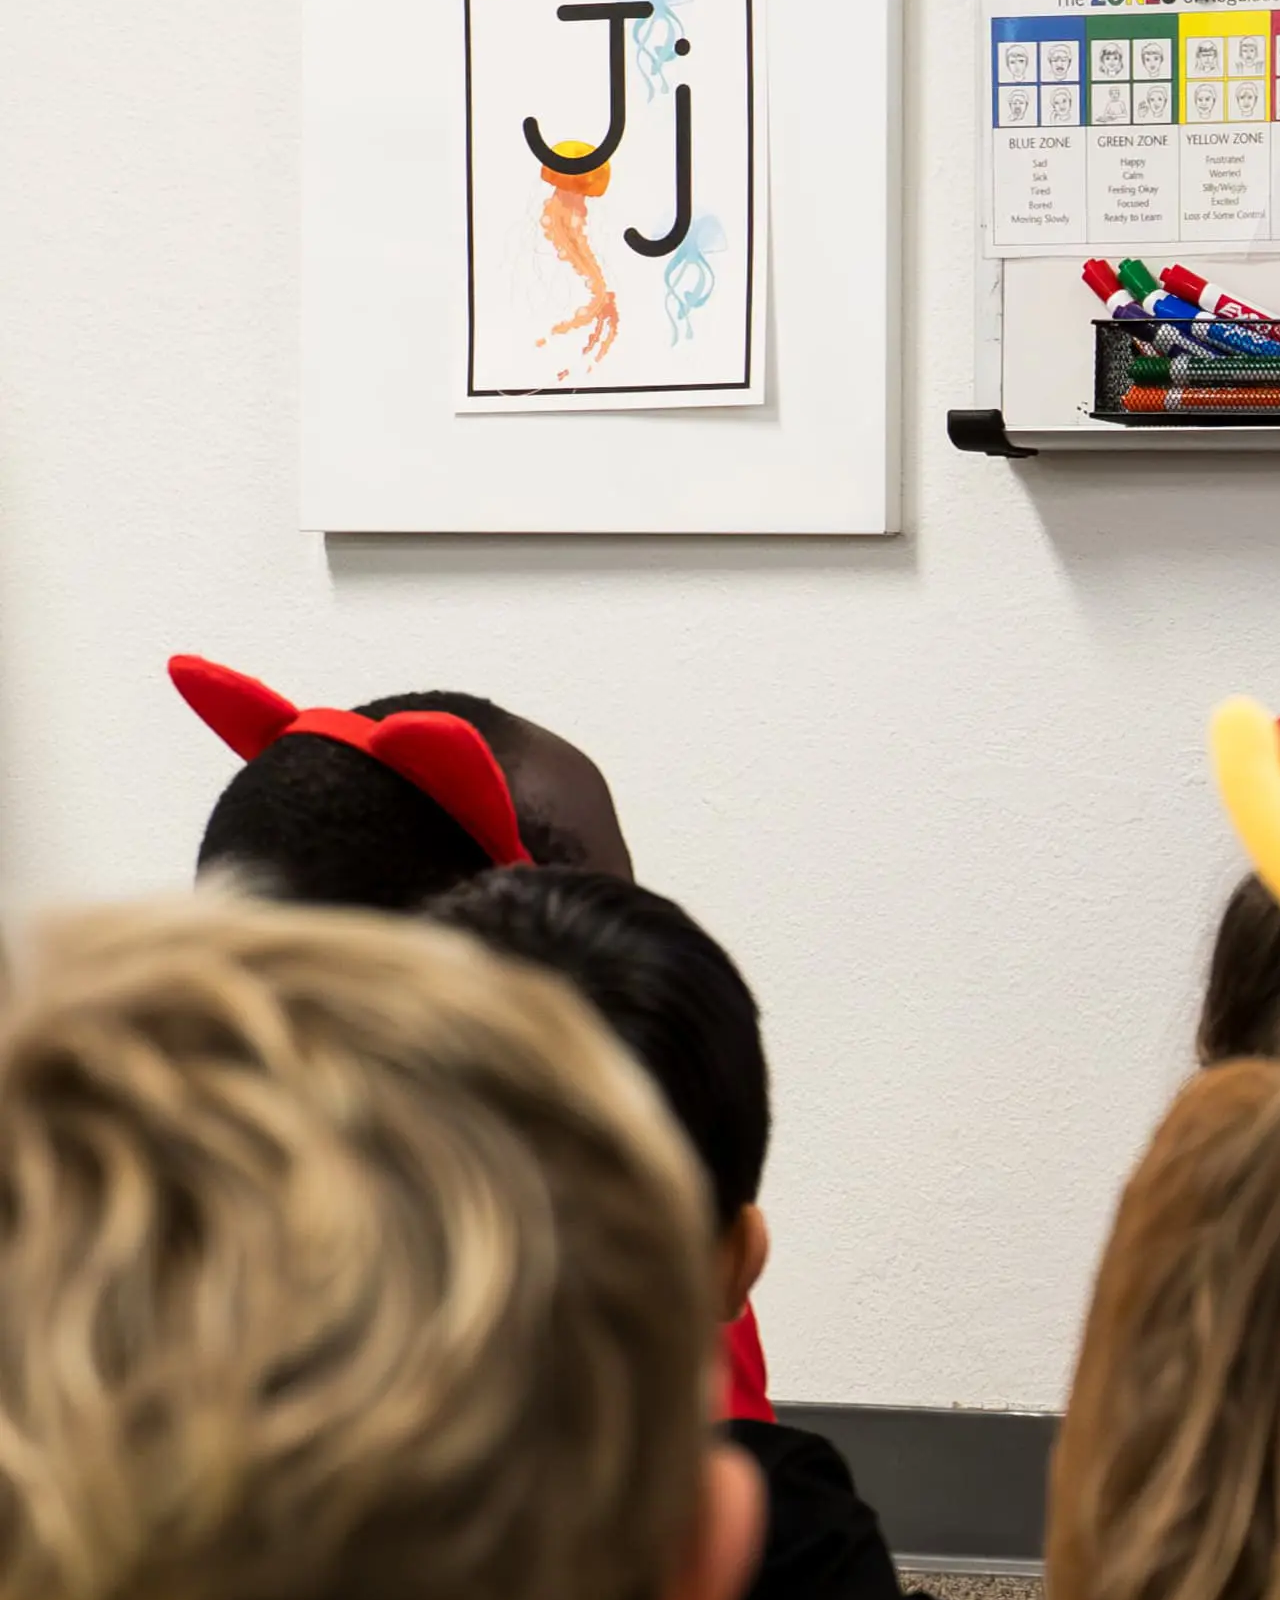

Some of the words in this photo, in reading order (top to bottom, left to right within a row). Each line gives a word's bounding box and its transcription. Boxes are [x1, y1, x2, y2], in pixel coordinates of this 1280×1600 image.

[1009, 137, 1035, 150] BLUE
[1039, 136, 1071, 149] ZONE
[1097, 135, 1133, 148] GREEN
[1137, 134, 1168, 147] ZONE
[1186, 133, 1230, 146] YELLOW
[1233, 131, 1264, 144] ZONE
[1032, 158, 1048, 168] Sad
[1120, 158, 1146, 168] Happy
[1205, 154, 1245, 164] Frustrated
[1122, 171, 1144, 181] Calm
[1209, 168, 1242, 178] Worried
[1030, 186, 1051, 196] Tired
[1108, 185, 1136, 196] Feeling
[1028, 200, 1053, 210] Bored
[1117, 199, 1150, 209] Focused
[1104, 213, 1128, 223] Ready
[1130, 213, 1139, 222] to
[1140, 212, 1163, 222] Learn
